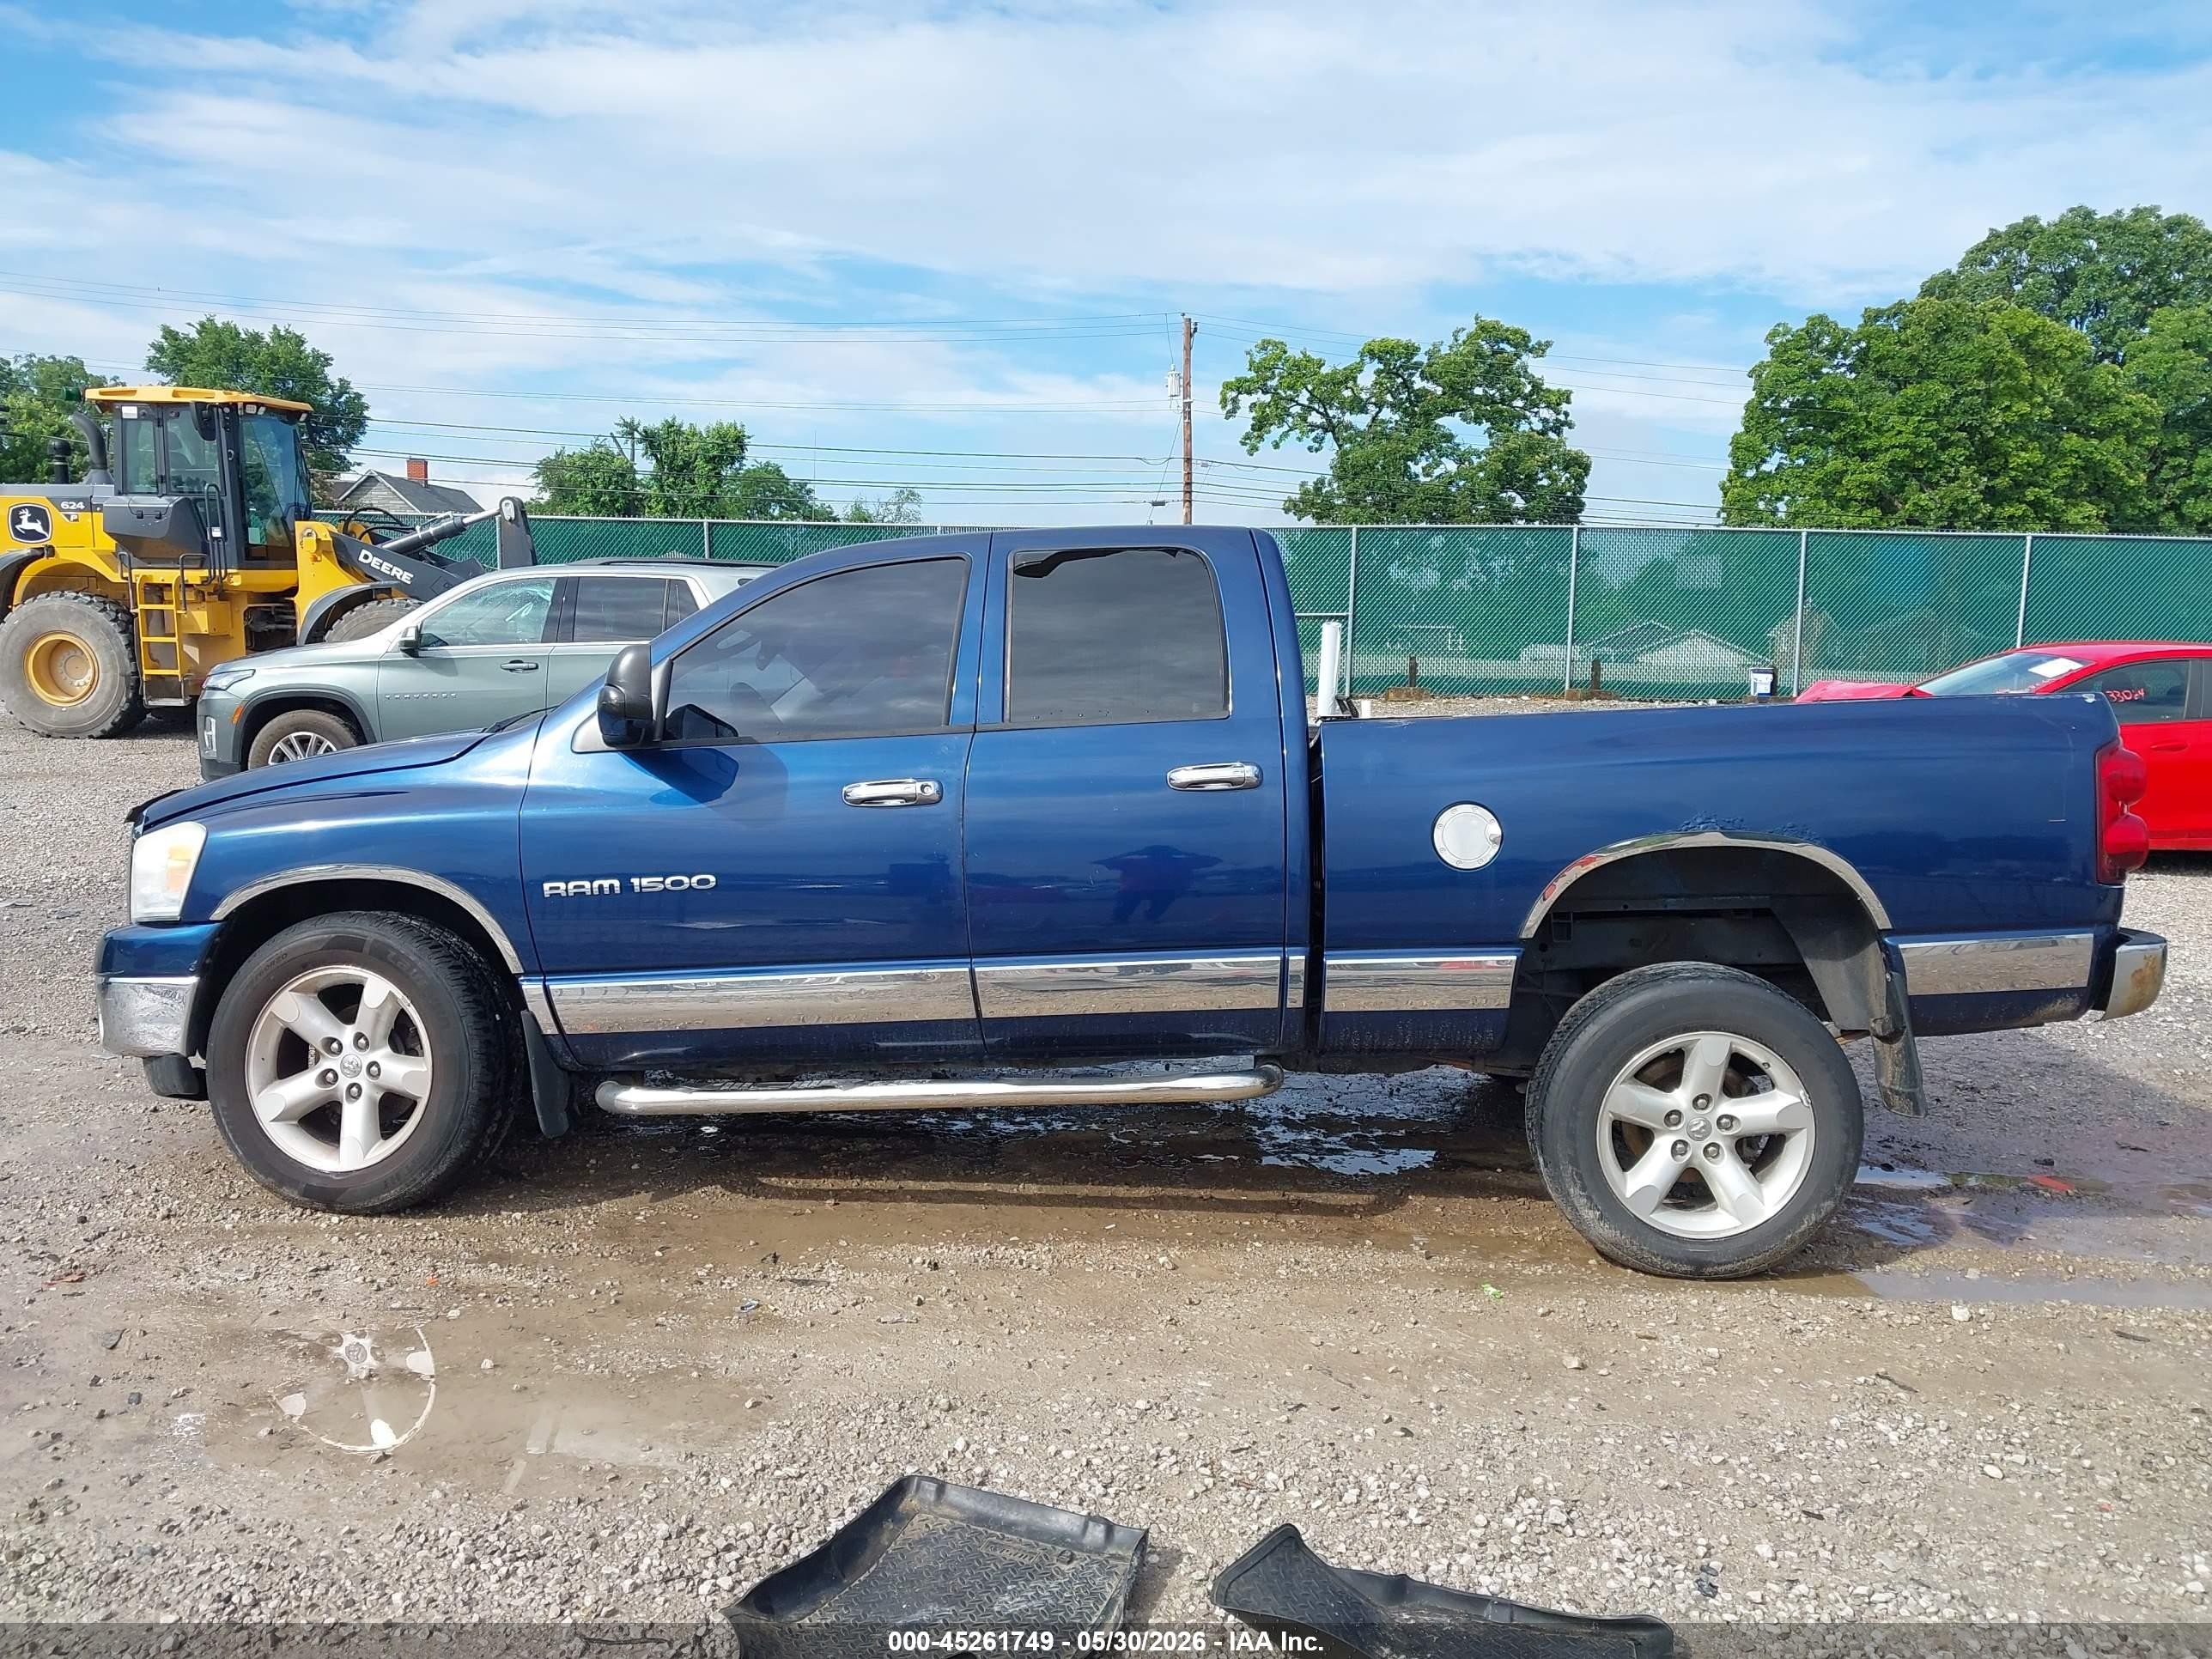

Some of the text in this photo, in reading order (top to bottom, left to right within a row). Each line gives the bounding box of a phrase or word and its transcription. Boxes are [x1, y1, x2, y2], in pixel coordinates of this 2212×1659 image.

[60, 501, 85, 510] 624
[358, 548, 414, 586] DEERE
[543, 874, 717, 898] RAM 1500
